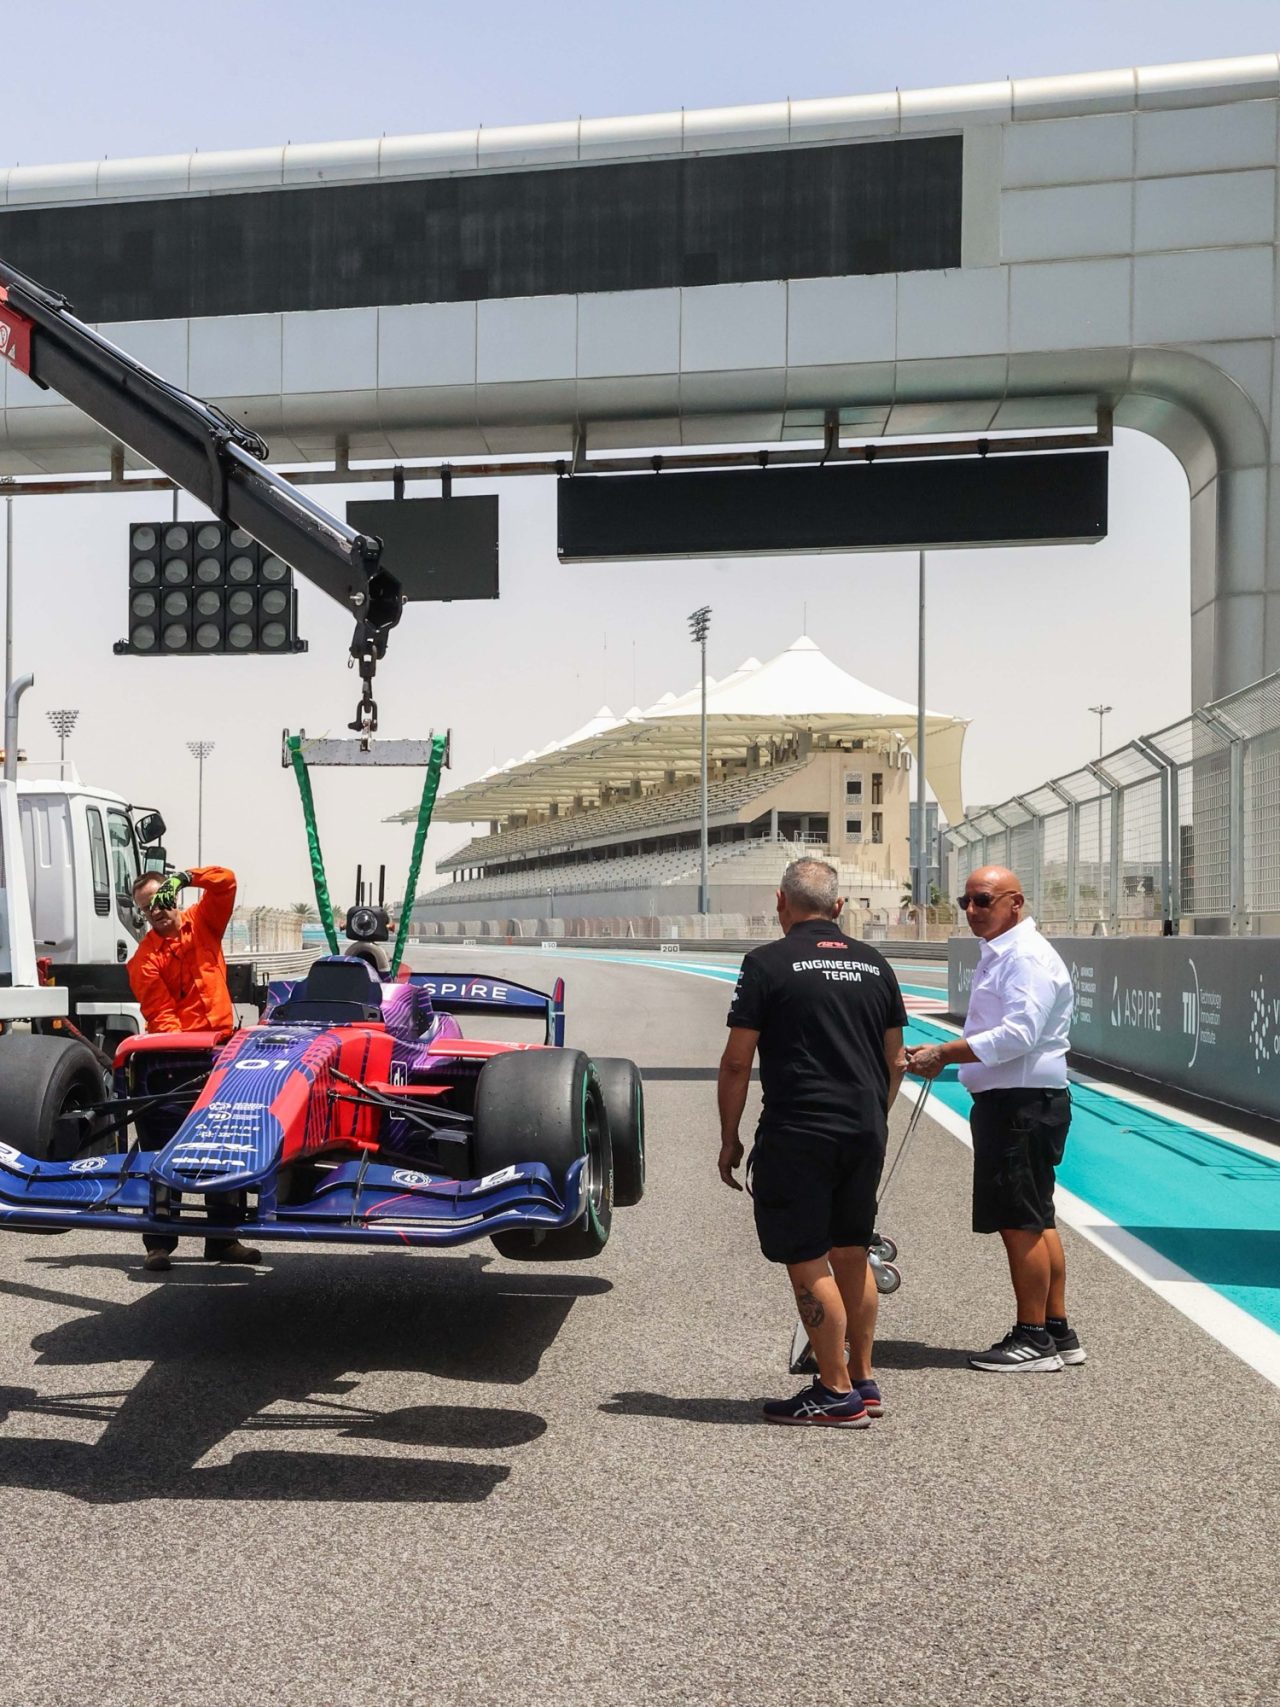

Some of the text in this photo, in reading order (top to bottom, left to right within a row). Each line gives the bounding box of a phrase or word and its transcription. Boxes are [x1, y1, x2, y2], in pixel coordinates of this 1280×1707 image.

[662, 945, 678, 953] 200
[792, 959, 880, 976] ENGINEERING
[822, 971, 862, 982] TEAM
[420, 982, 508, 1001] SPIRE
[1124, 988, 1162, 1031] ASPIRE
[1182, 991, 1196, 1035] TII
[235, 1059, 289, 1071] 01
[172, 1156, 246, 1167] dallara
